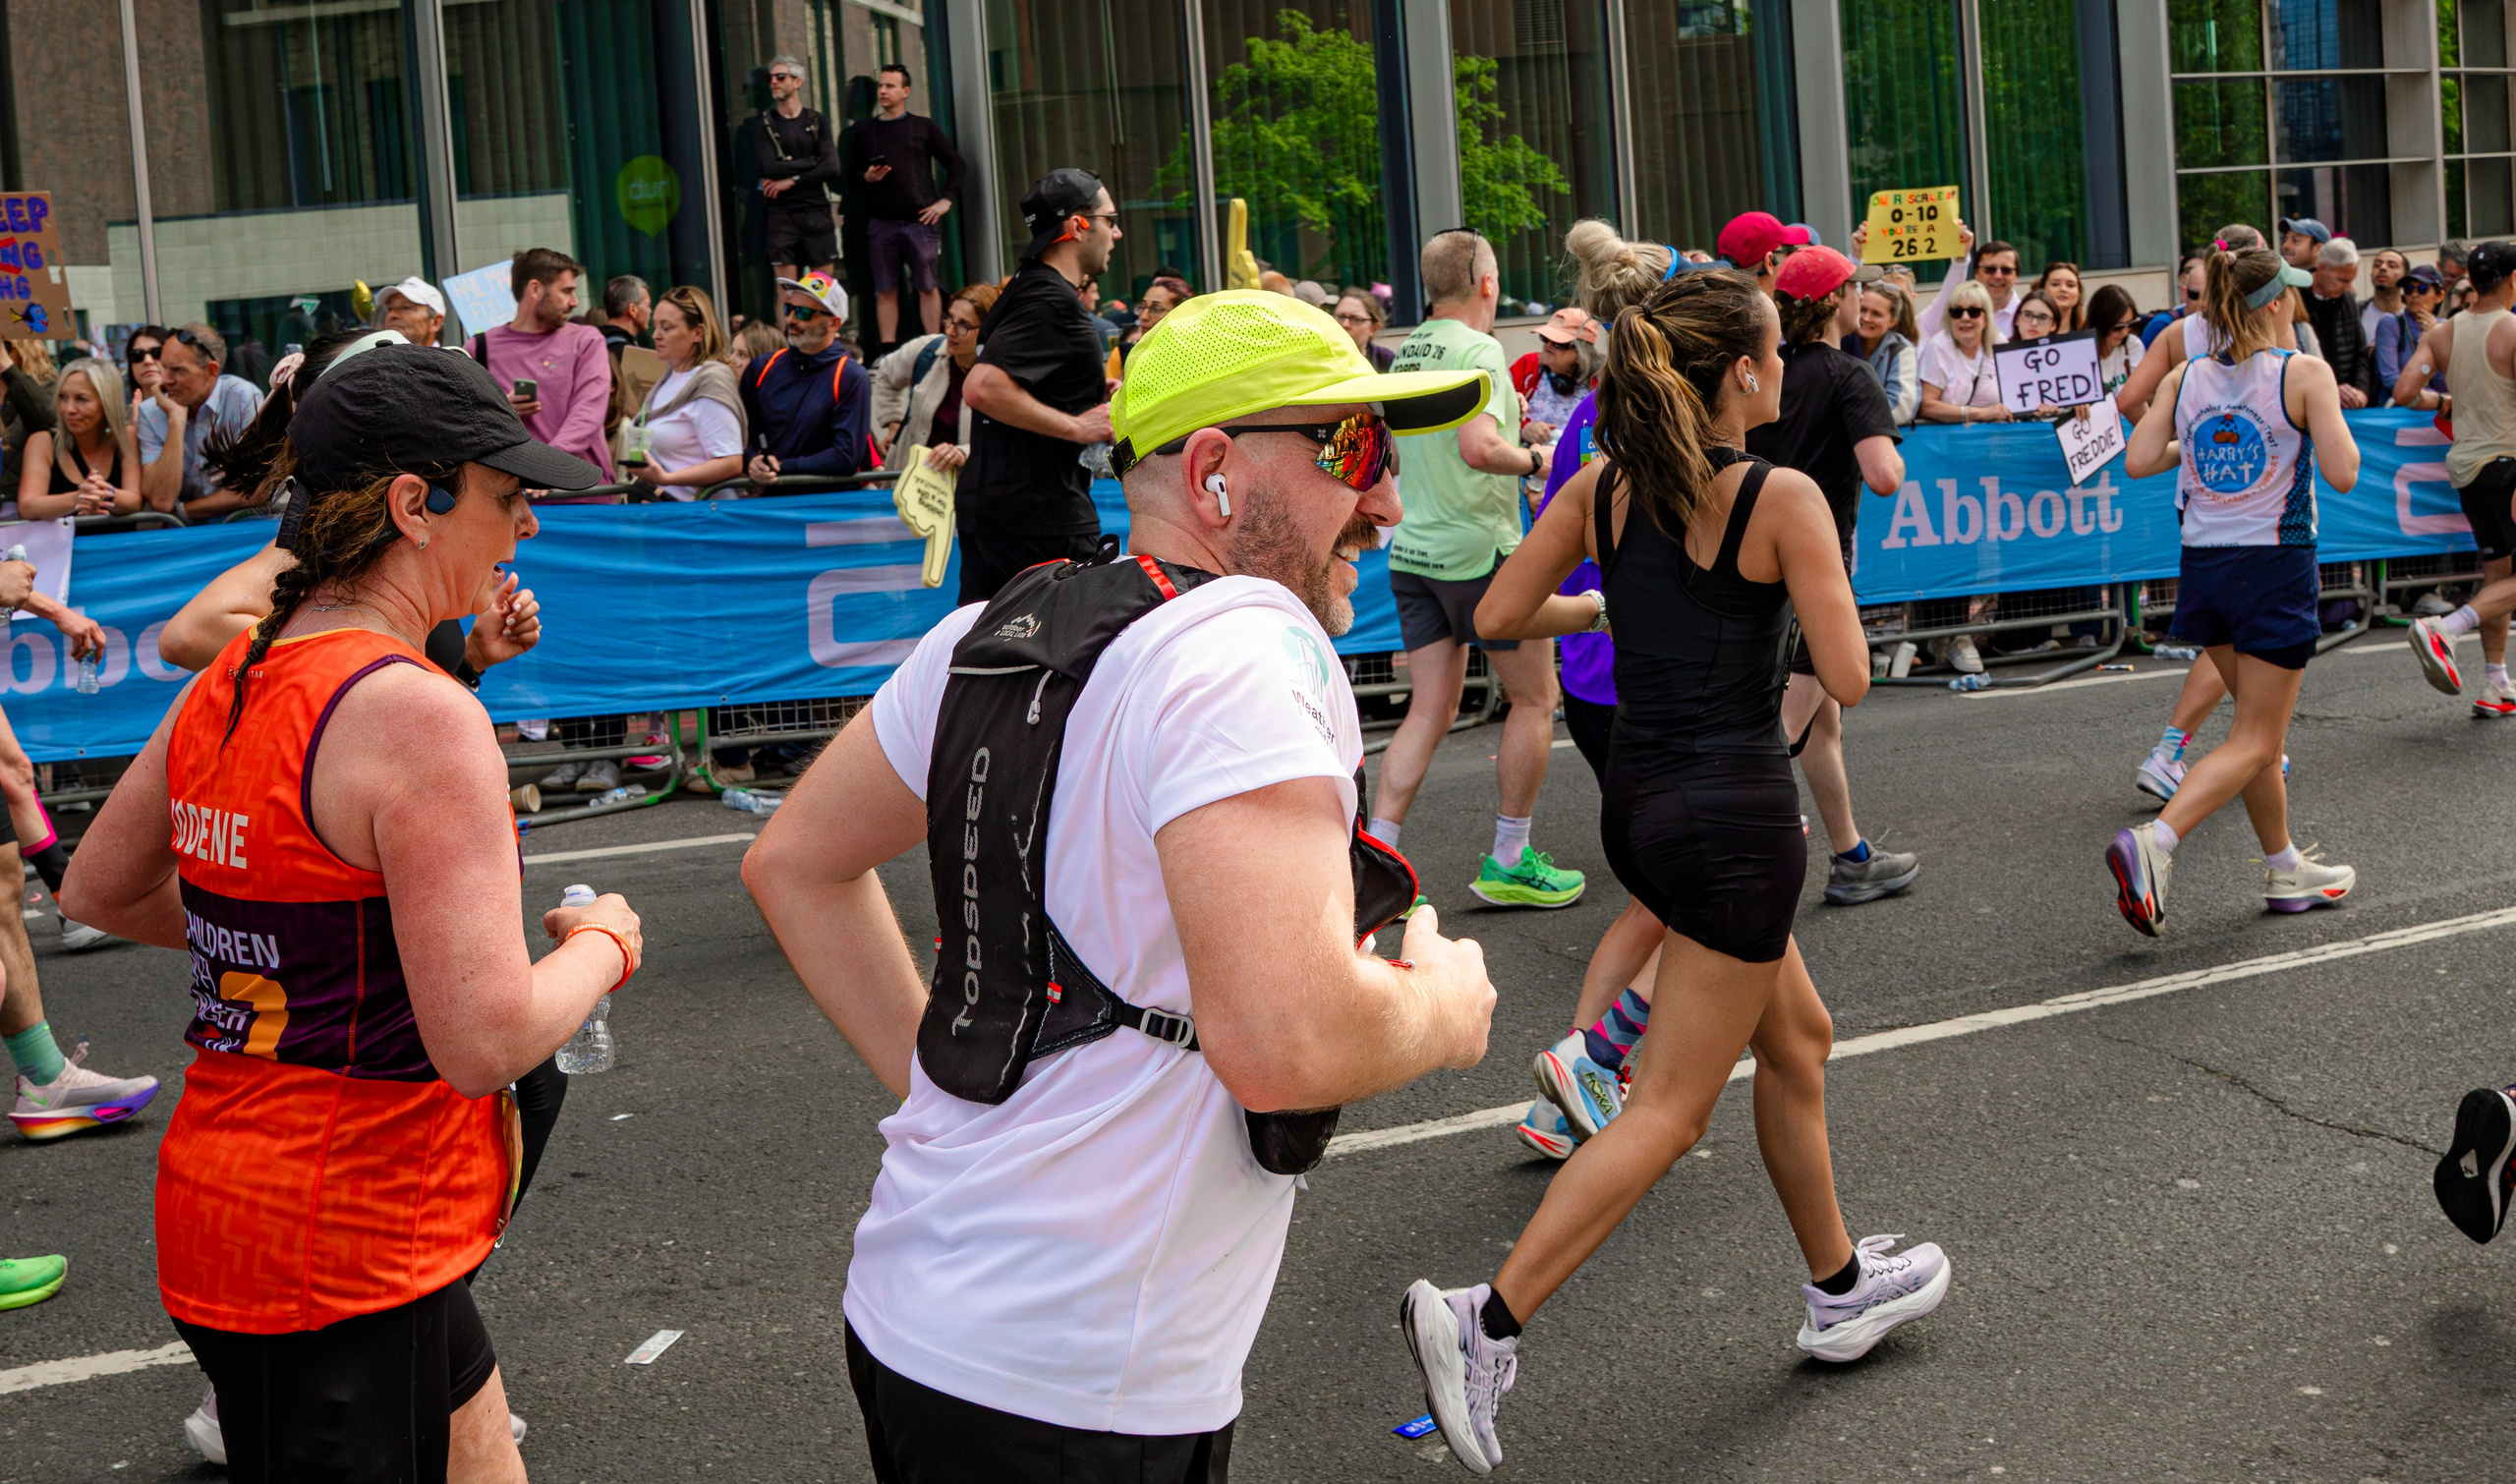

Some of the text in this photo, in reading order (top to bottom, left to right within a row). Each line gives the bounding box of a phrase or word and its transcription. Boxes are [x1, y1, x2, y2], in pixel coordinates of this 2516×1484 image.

[1894, 194, 1902, 204] A
[1908, 192, 1943, 204] SCALE
[1926, 224, 1936, 233] A
[1892, 238, 1937, 257] 26.2
[2025, 348, 2060, 373] GO
[2017, 362, 2099, 408] FRED!
[2072, 419, 2091, 442] GO
[2197, 443, 2260, 462] HARRY'S
[2203, 462, 2255, 485] HAT
[1881, 470, 2123, 550] Abbott
[951, 747, 991, 1037] TOPSPEED
[573, 923, 607, 933] Cancer
[1583, 1071, 1614, 1115] HOKA
